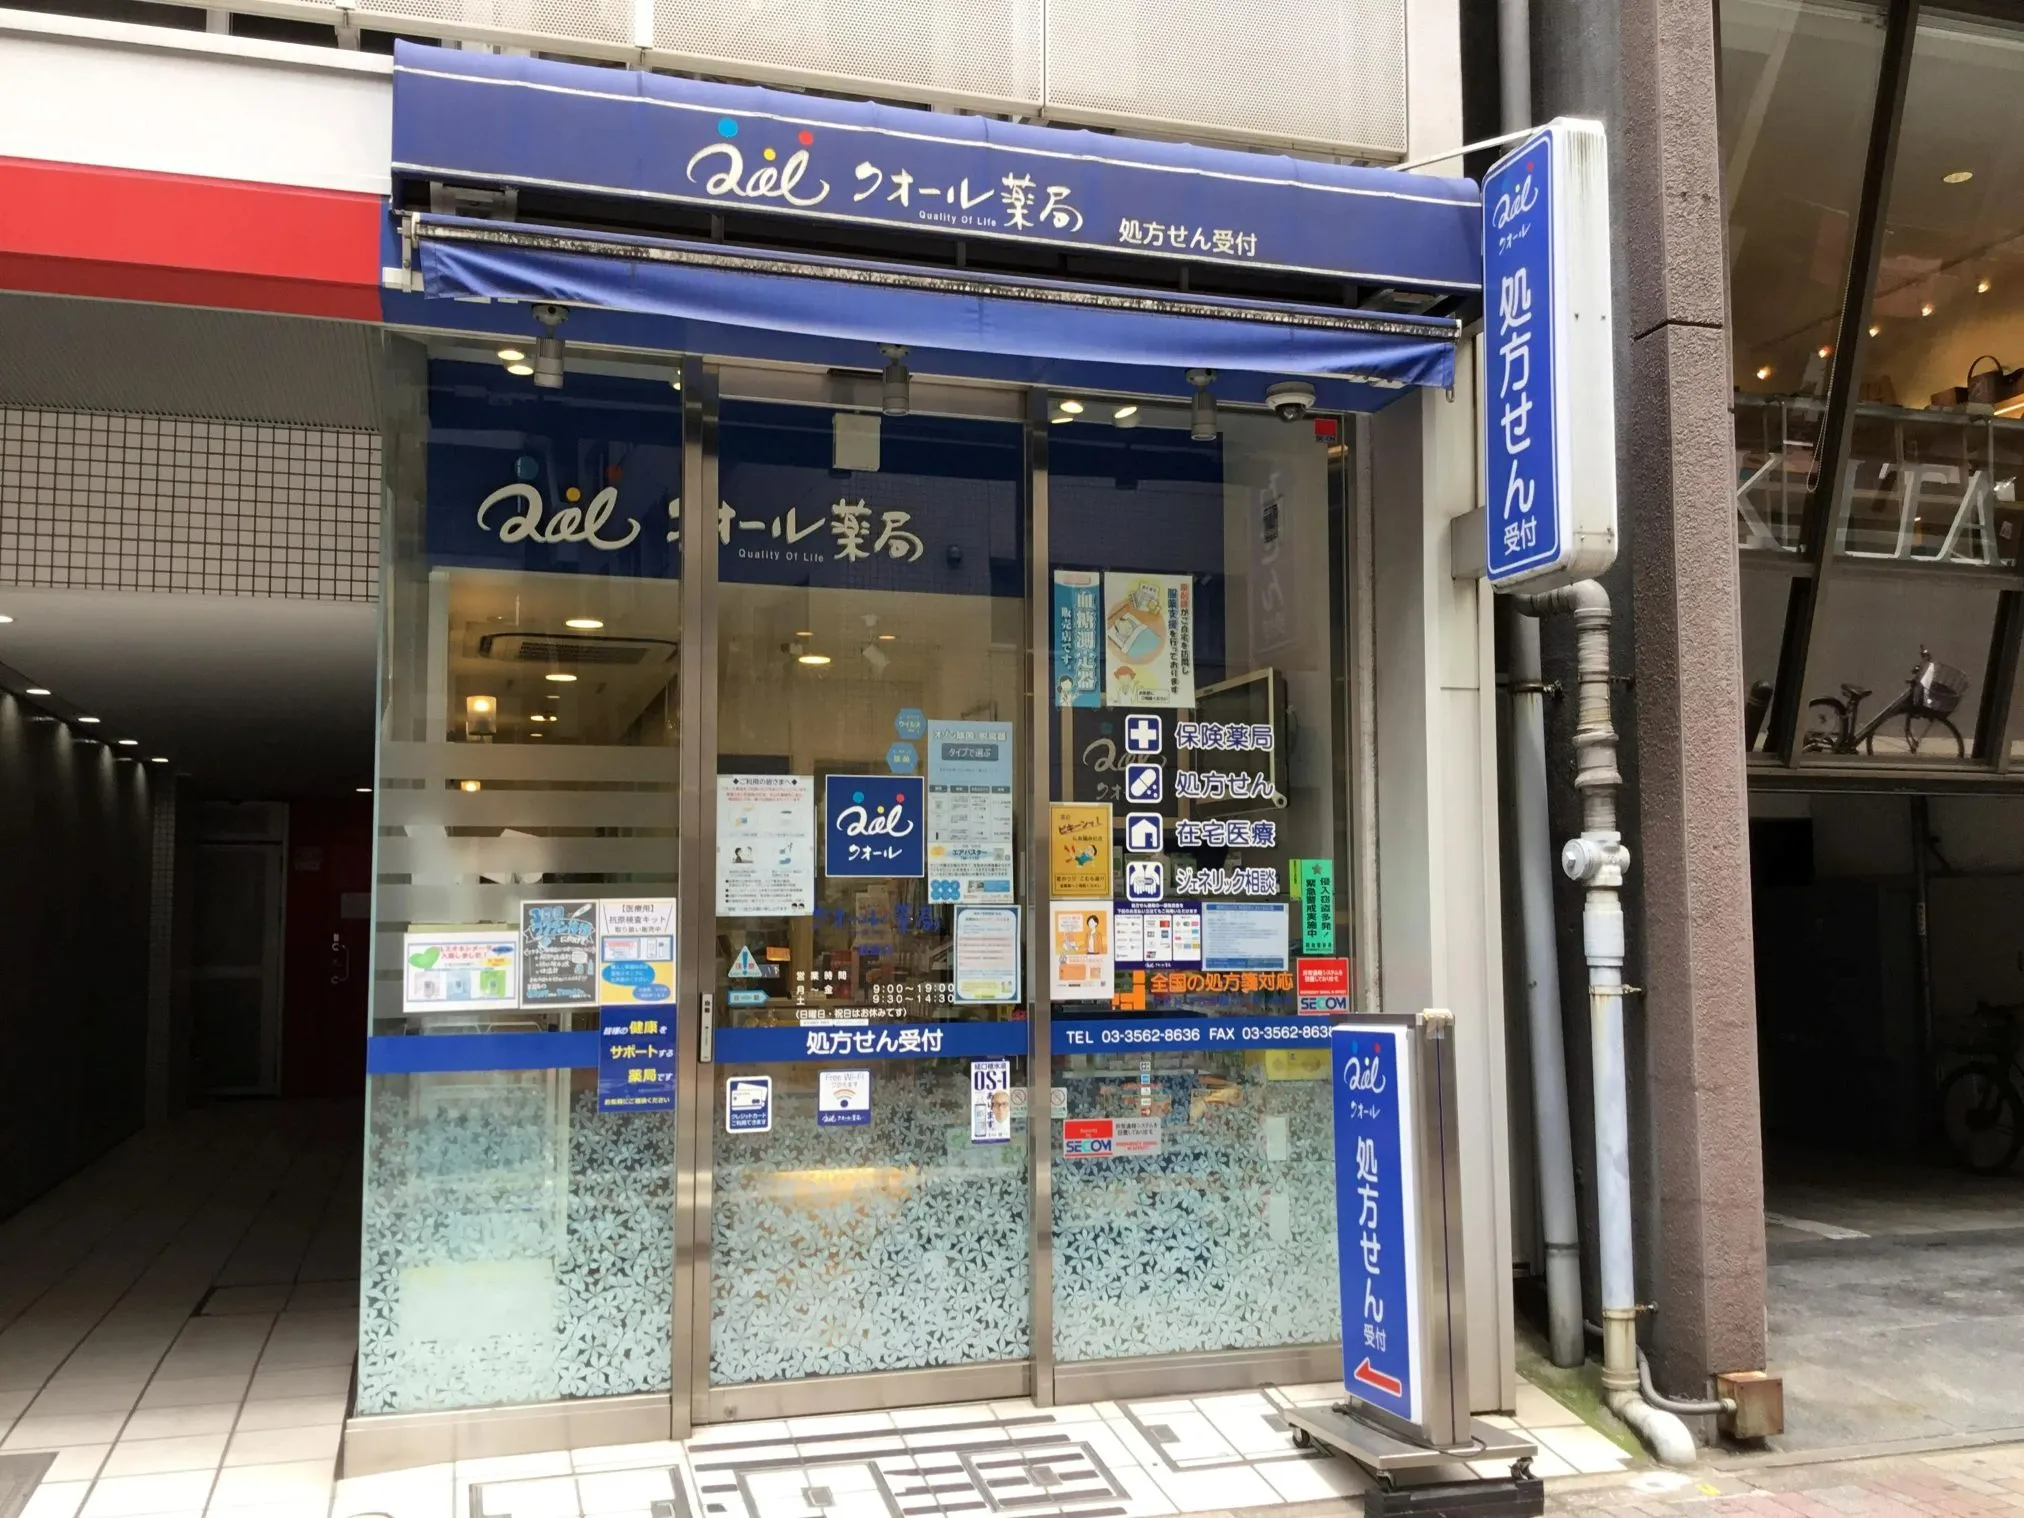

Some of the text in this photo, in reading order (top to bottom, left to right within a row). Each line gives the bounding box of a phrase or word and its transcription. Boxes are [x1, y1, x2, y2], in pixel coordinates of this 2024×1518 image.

[918, 209, 998, 228] Quality Of Life
[1118, 217, 1259, 258] 処方せん受付
[1498, 223, 1532, 256] クオール
[1498, 264, 1536, 520] 処方せん
[1503, 518, 1538, 556] 受付
[738, 548, 825, 563] Quality Of Life
[1175, 723, 1275, 751] 保険薬局
[1175, 771, 1275, 799] 処方せん
[1175, 819, 1276, 848] 在宅医療
[848, 844, 903, 861] クオール
[1176, 867, 1277, 897] ジェネリック相談
[796, 970, 848, 982] 営業時間
[1150, 971, 1295, 993] 全国の処方箋対応
[796, 997, 806, 1006] 土
[1300, 996, 1347, 1010] SECOM
[806, 1027, 944, 1056] 処方せん受付
[1066, 1030, 1094, 1044] TEL
[1101, 1028, 1201, 1043] 03-3562-8636
[1209, 1027, 1235, 1041] FAX
[610, 1044, 675, 1060] サポートする
[628, 1068, 674, 1084] 薬局です
[974, 1070, 1007, 1091] OS-1
[1349, 1100, 1381, 1120] クオール
[1066, 1139, 1112, 1153] SECOM
[1355, 1135, 1385, 1322] 処方せん
[1363, 1322, 1387, 1353] 受付
